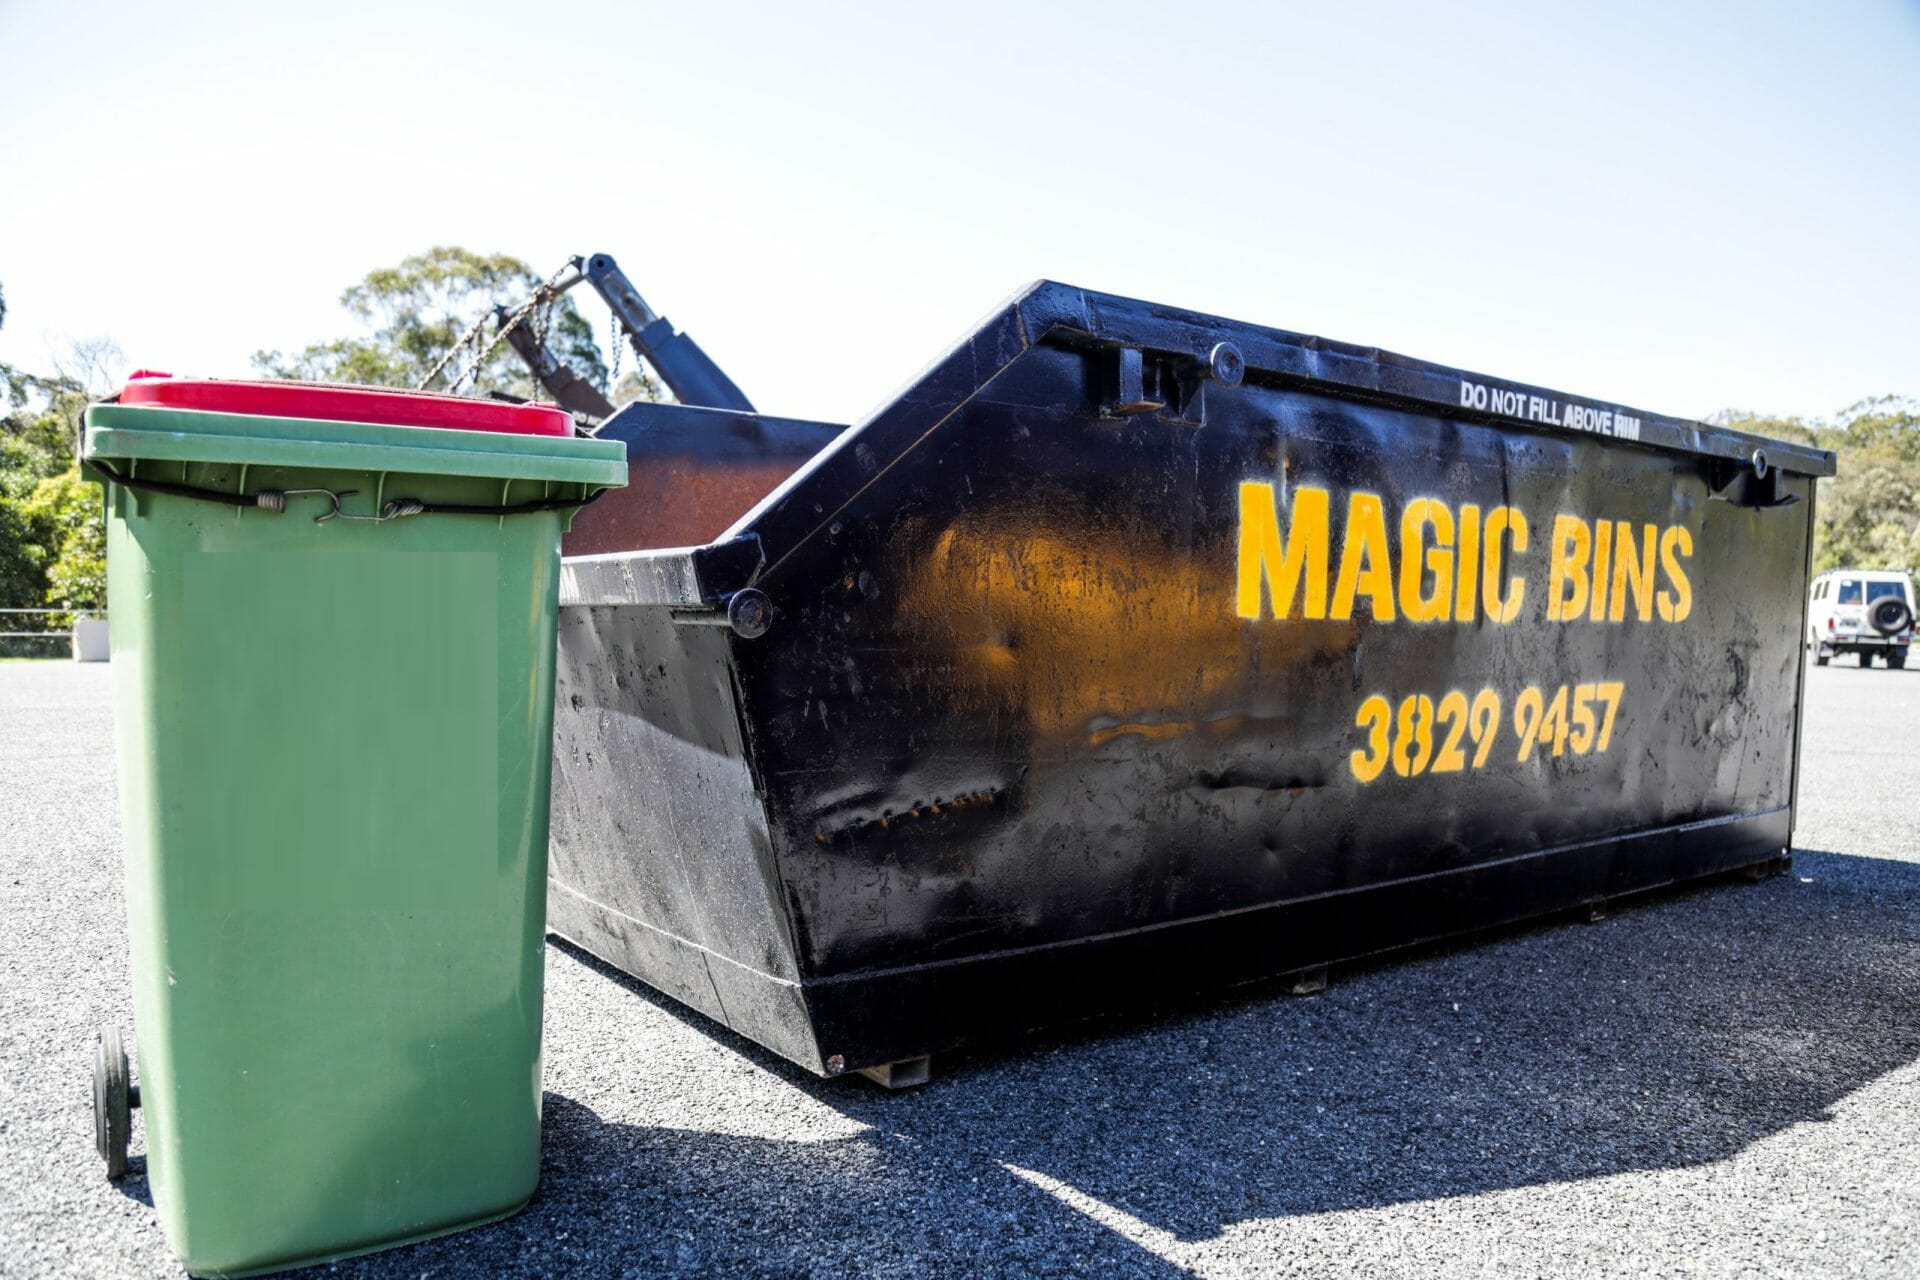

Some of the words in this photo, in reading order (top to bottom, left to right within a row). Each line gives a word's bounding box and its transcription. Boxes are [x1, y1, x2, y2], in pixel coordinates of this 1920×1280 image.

[1460, 380, 1487, 410] DO
[1491, 388, 1527, 418] NOT
[1529, 396, 1560, 426] FILL
[1563, 404, 1612, 435] ABOVE
[1614, 413, 1640, 440] RIM
[1236, 480, 1528, 624] MAGIC
[1547, 512, 1694, 623] BINS
[1350, 689, 1500, 782] 3829
[1514, 681, 1625, 762] 9457
